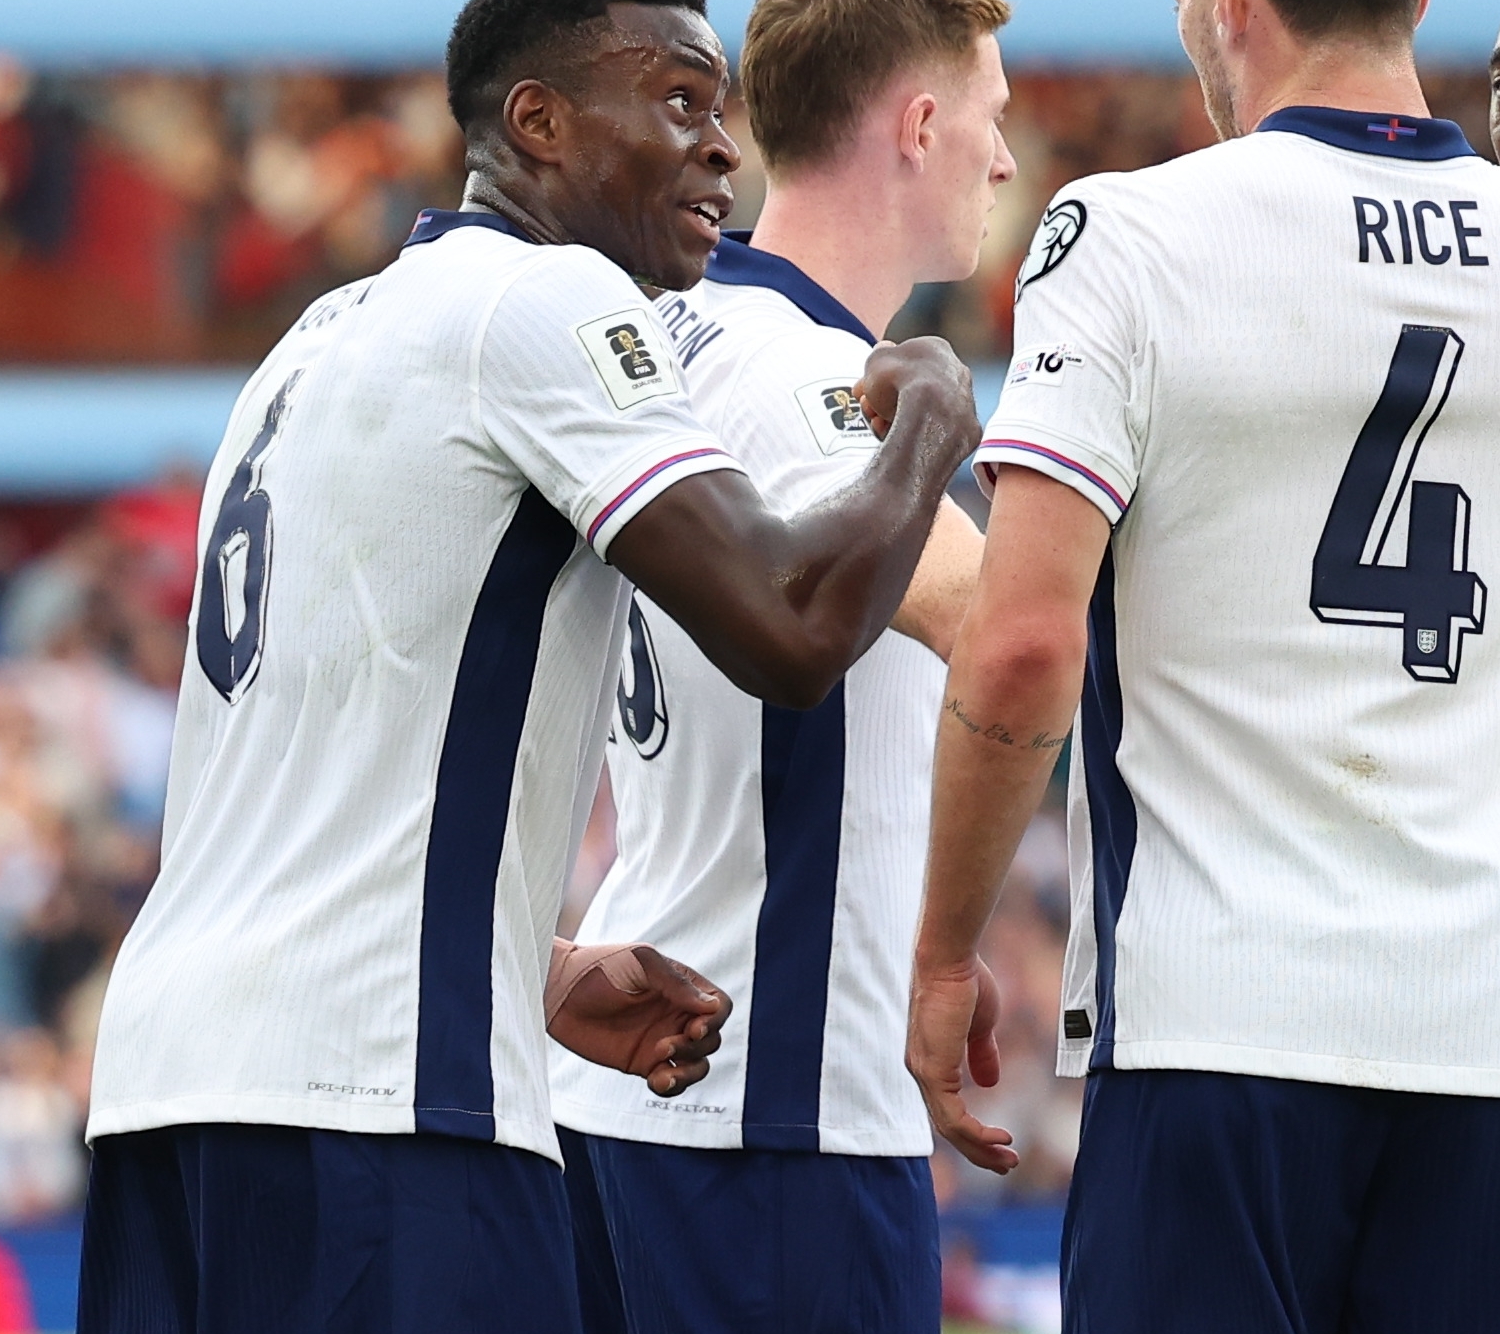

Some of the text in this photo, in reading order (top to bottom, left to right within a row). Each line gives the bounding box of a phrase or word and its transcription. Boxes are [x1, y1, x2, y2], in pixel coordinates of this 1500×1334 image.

[1353, 196, 1490, 268] RICE
[195, 367, 305, 707] 6
[1310, 324, 1487, 685] 4
